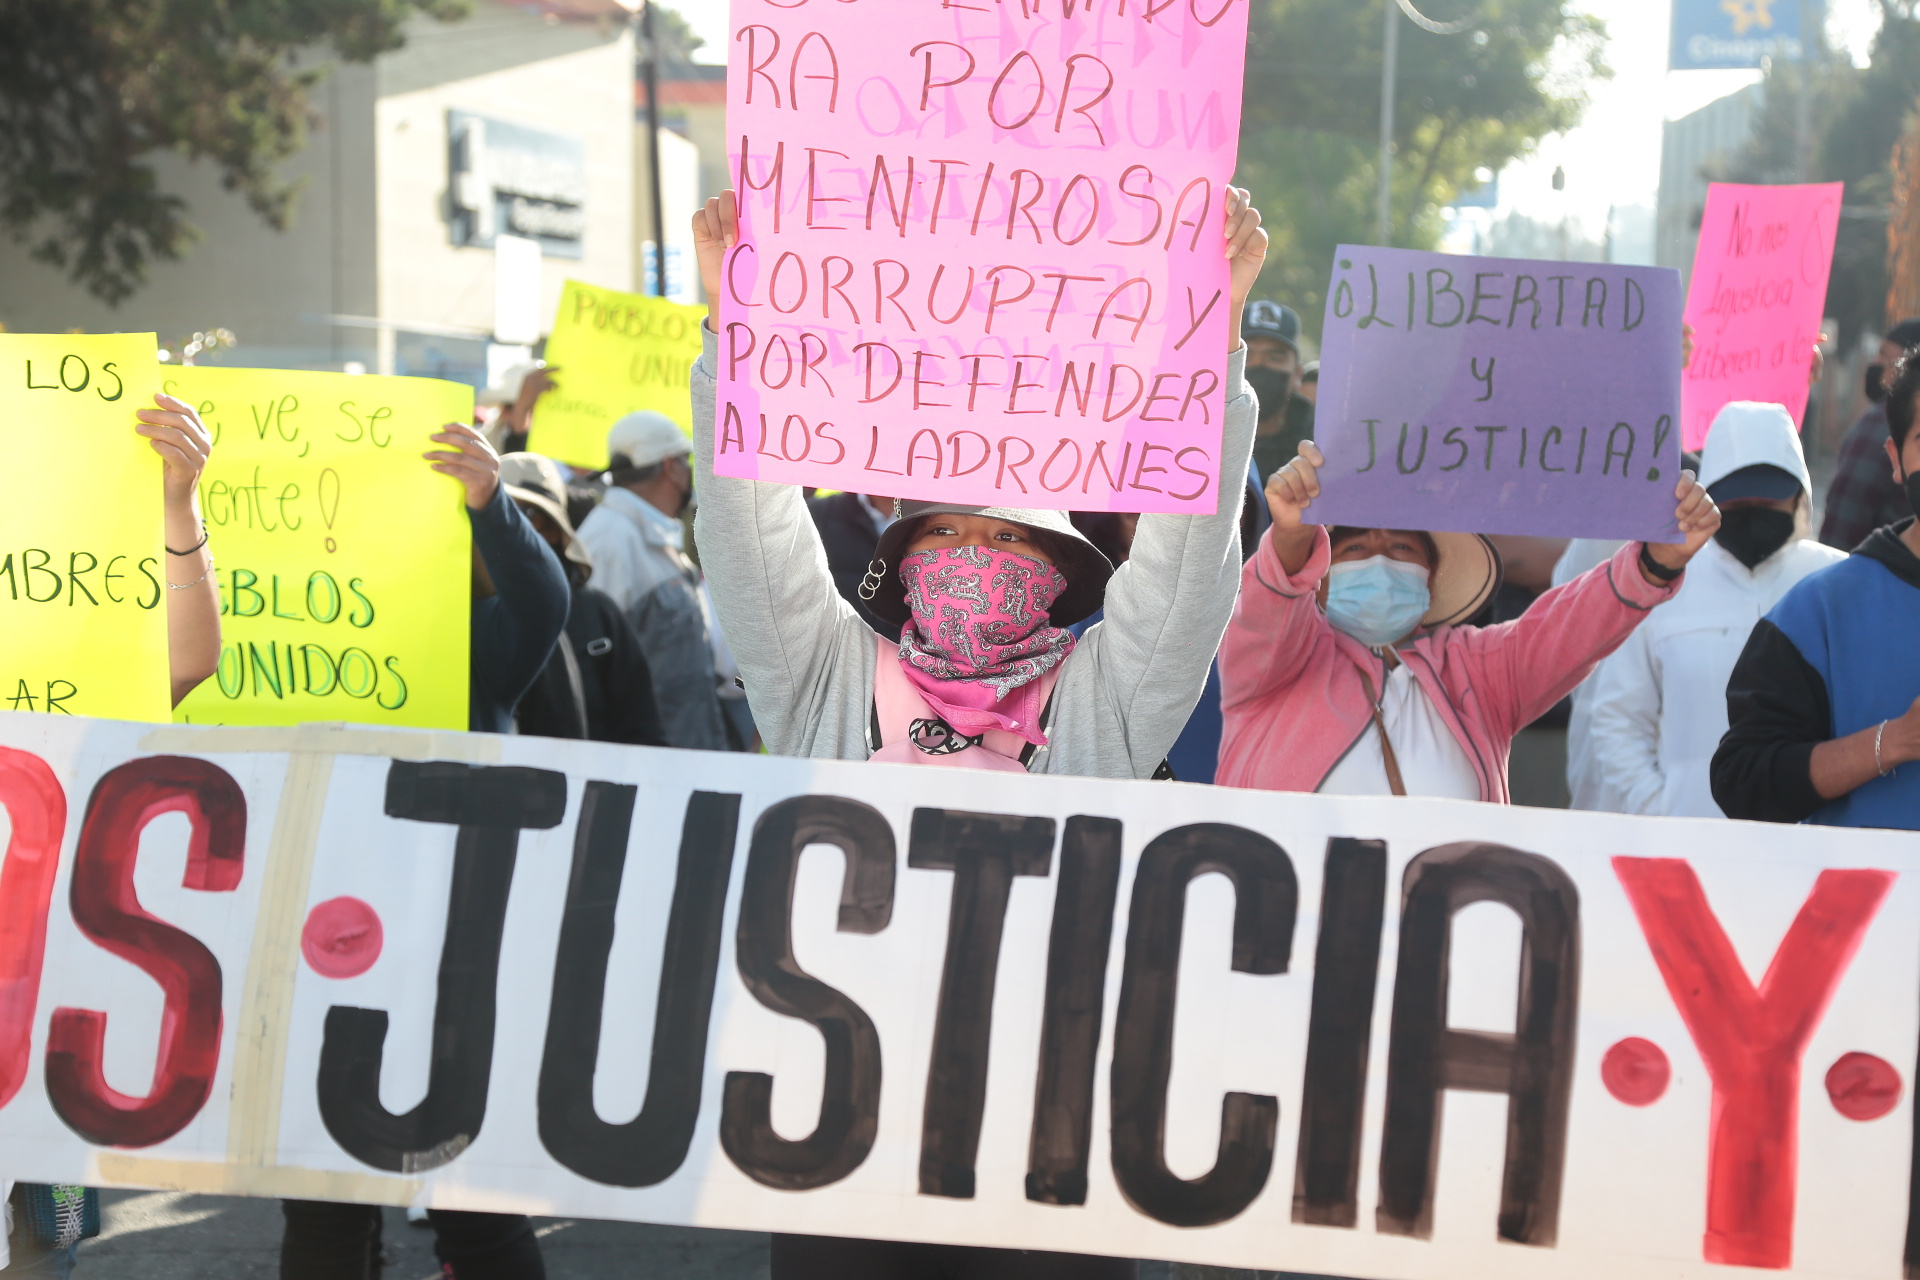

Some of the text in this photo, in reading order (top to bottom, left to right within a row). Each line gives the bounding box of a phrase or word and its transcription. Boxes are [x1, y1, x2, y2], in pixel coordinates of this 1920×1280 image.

[736, 24, 1114, 146] RA POR
[738, 135, 1212, 253] MENTIROSA
[727, 243, 1152, 343] CORRUPTA
[26, 354, 124, 402] LOS
[726, 321, 1219, 425] POR DEFENDER
[251, 394, 309, 458] ve,
[720, 401, 1212, 501] A LOS LADRONES
[1356, 413, 1672, 482] JUSTICIA!
[216, 640, 408, 710] UNIDOS
[317, 758, 1581, 1249] JUSTICIA
[1611, 855, 1899, 1269] Y
